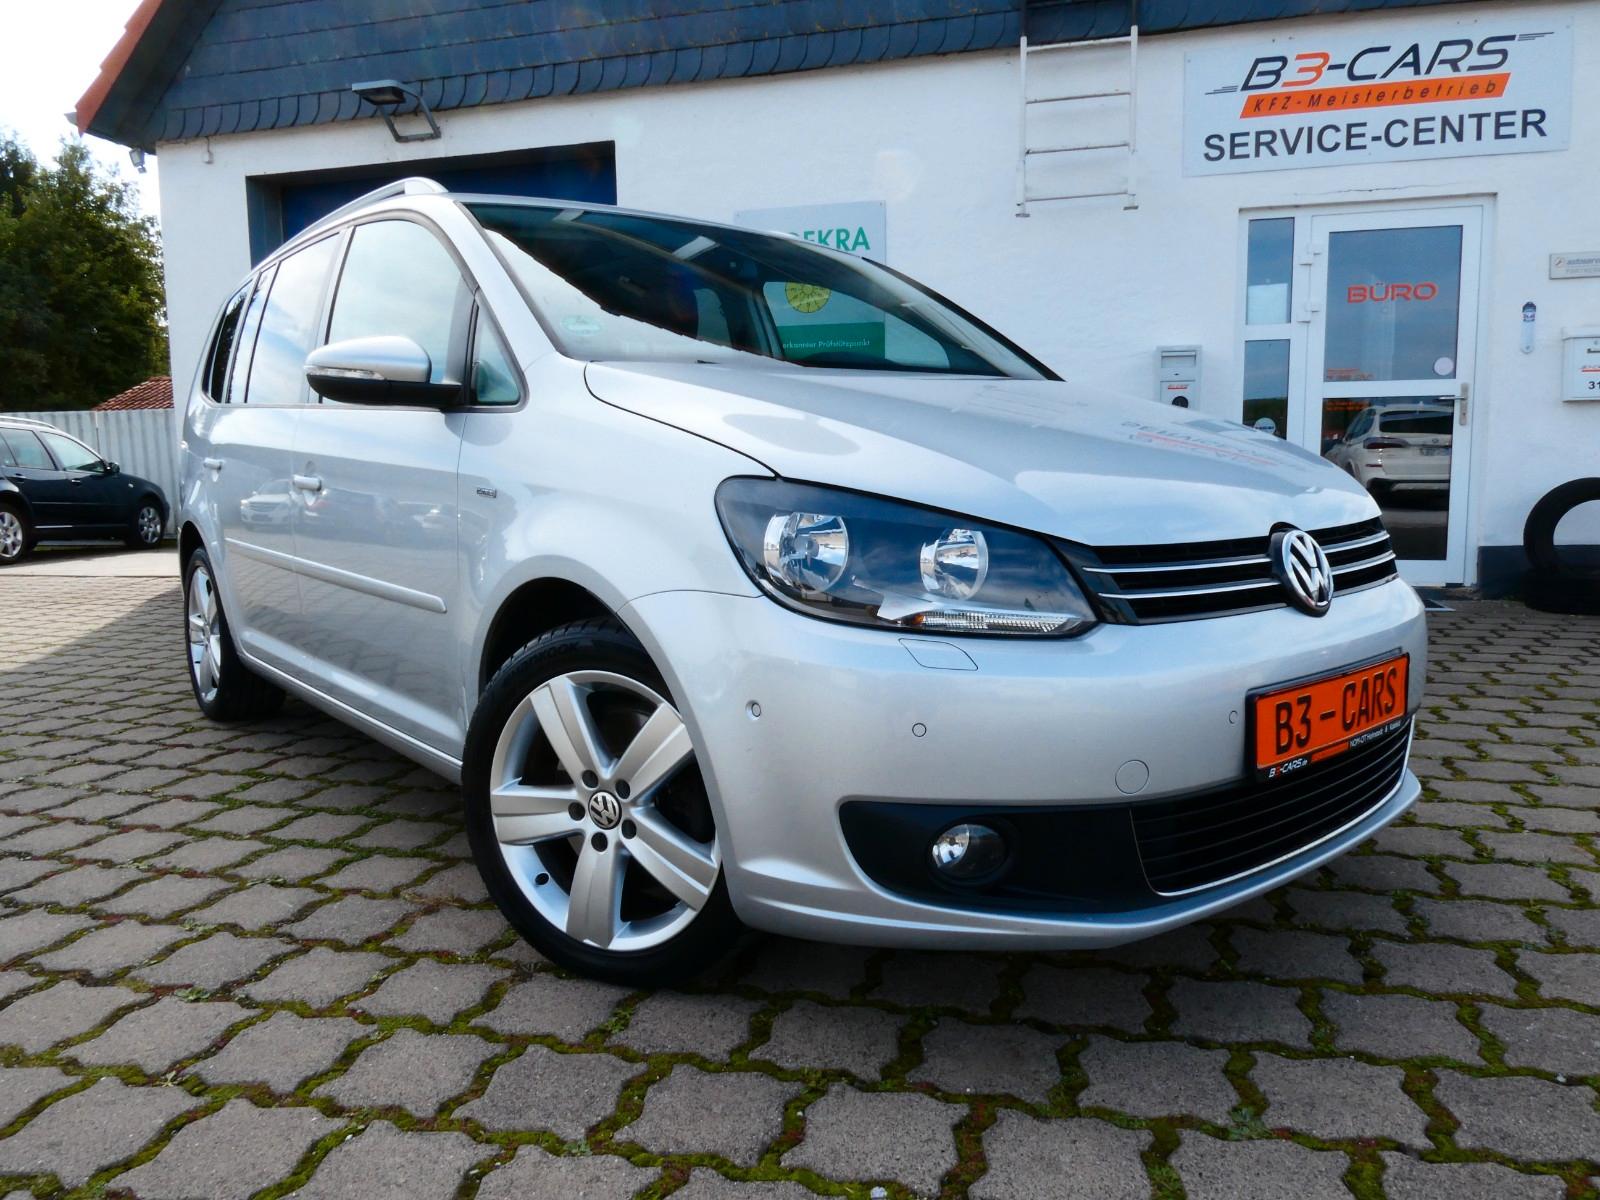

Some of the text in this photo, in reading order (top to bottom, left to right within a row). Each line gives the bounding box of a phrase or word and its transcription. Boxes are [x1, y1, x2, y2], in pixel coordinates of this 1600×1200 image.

[1239, 34, 1517, 92] B3-CARS
[1203, 108, 1548, 162] SERVICE-CENTER
[789, 226, 871, 251] EKRA
[1347, 281, 1438, 304] BÜRO
